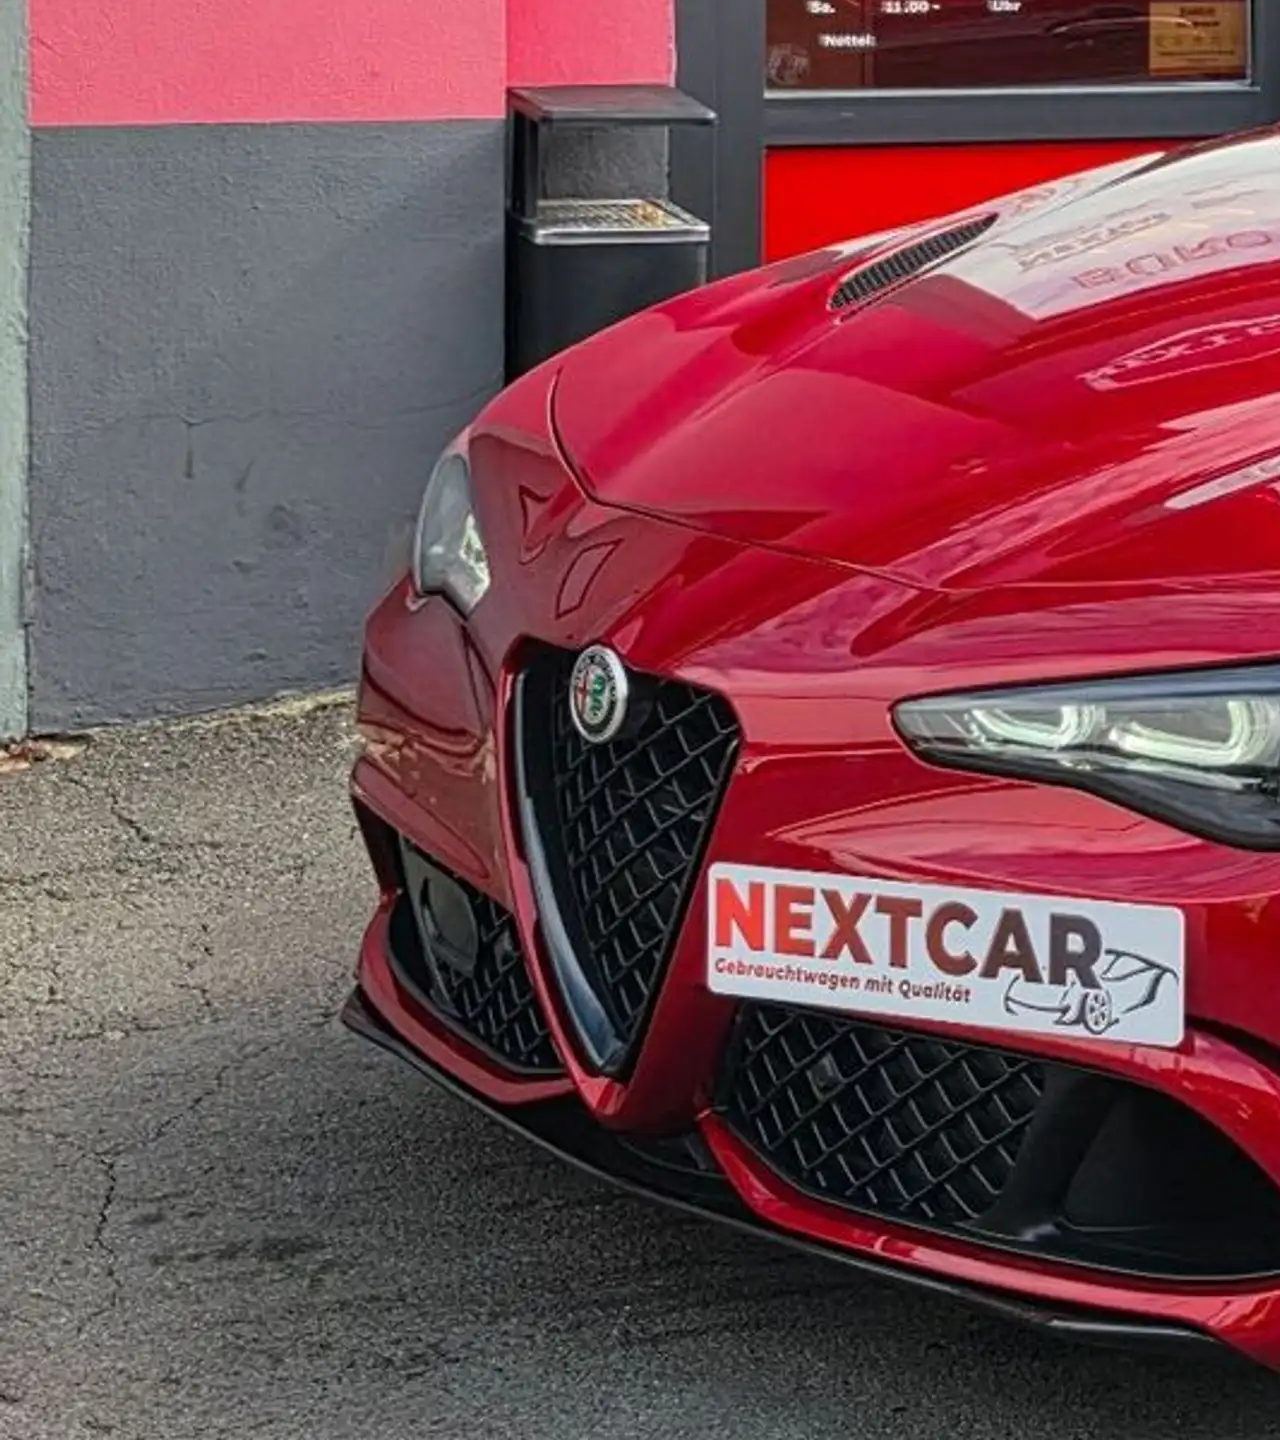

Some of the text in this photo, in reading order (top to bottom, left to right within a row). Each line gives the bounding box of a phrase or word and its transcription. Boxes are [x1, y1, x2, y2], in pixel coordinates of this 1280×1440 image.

[989, 0, 1023, 12] Uhr
[713, 876, 1104, 990] NEXTCAR
[714, 957, 972, 1004] Gebrauchtwagen mit Qualität
